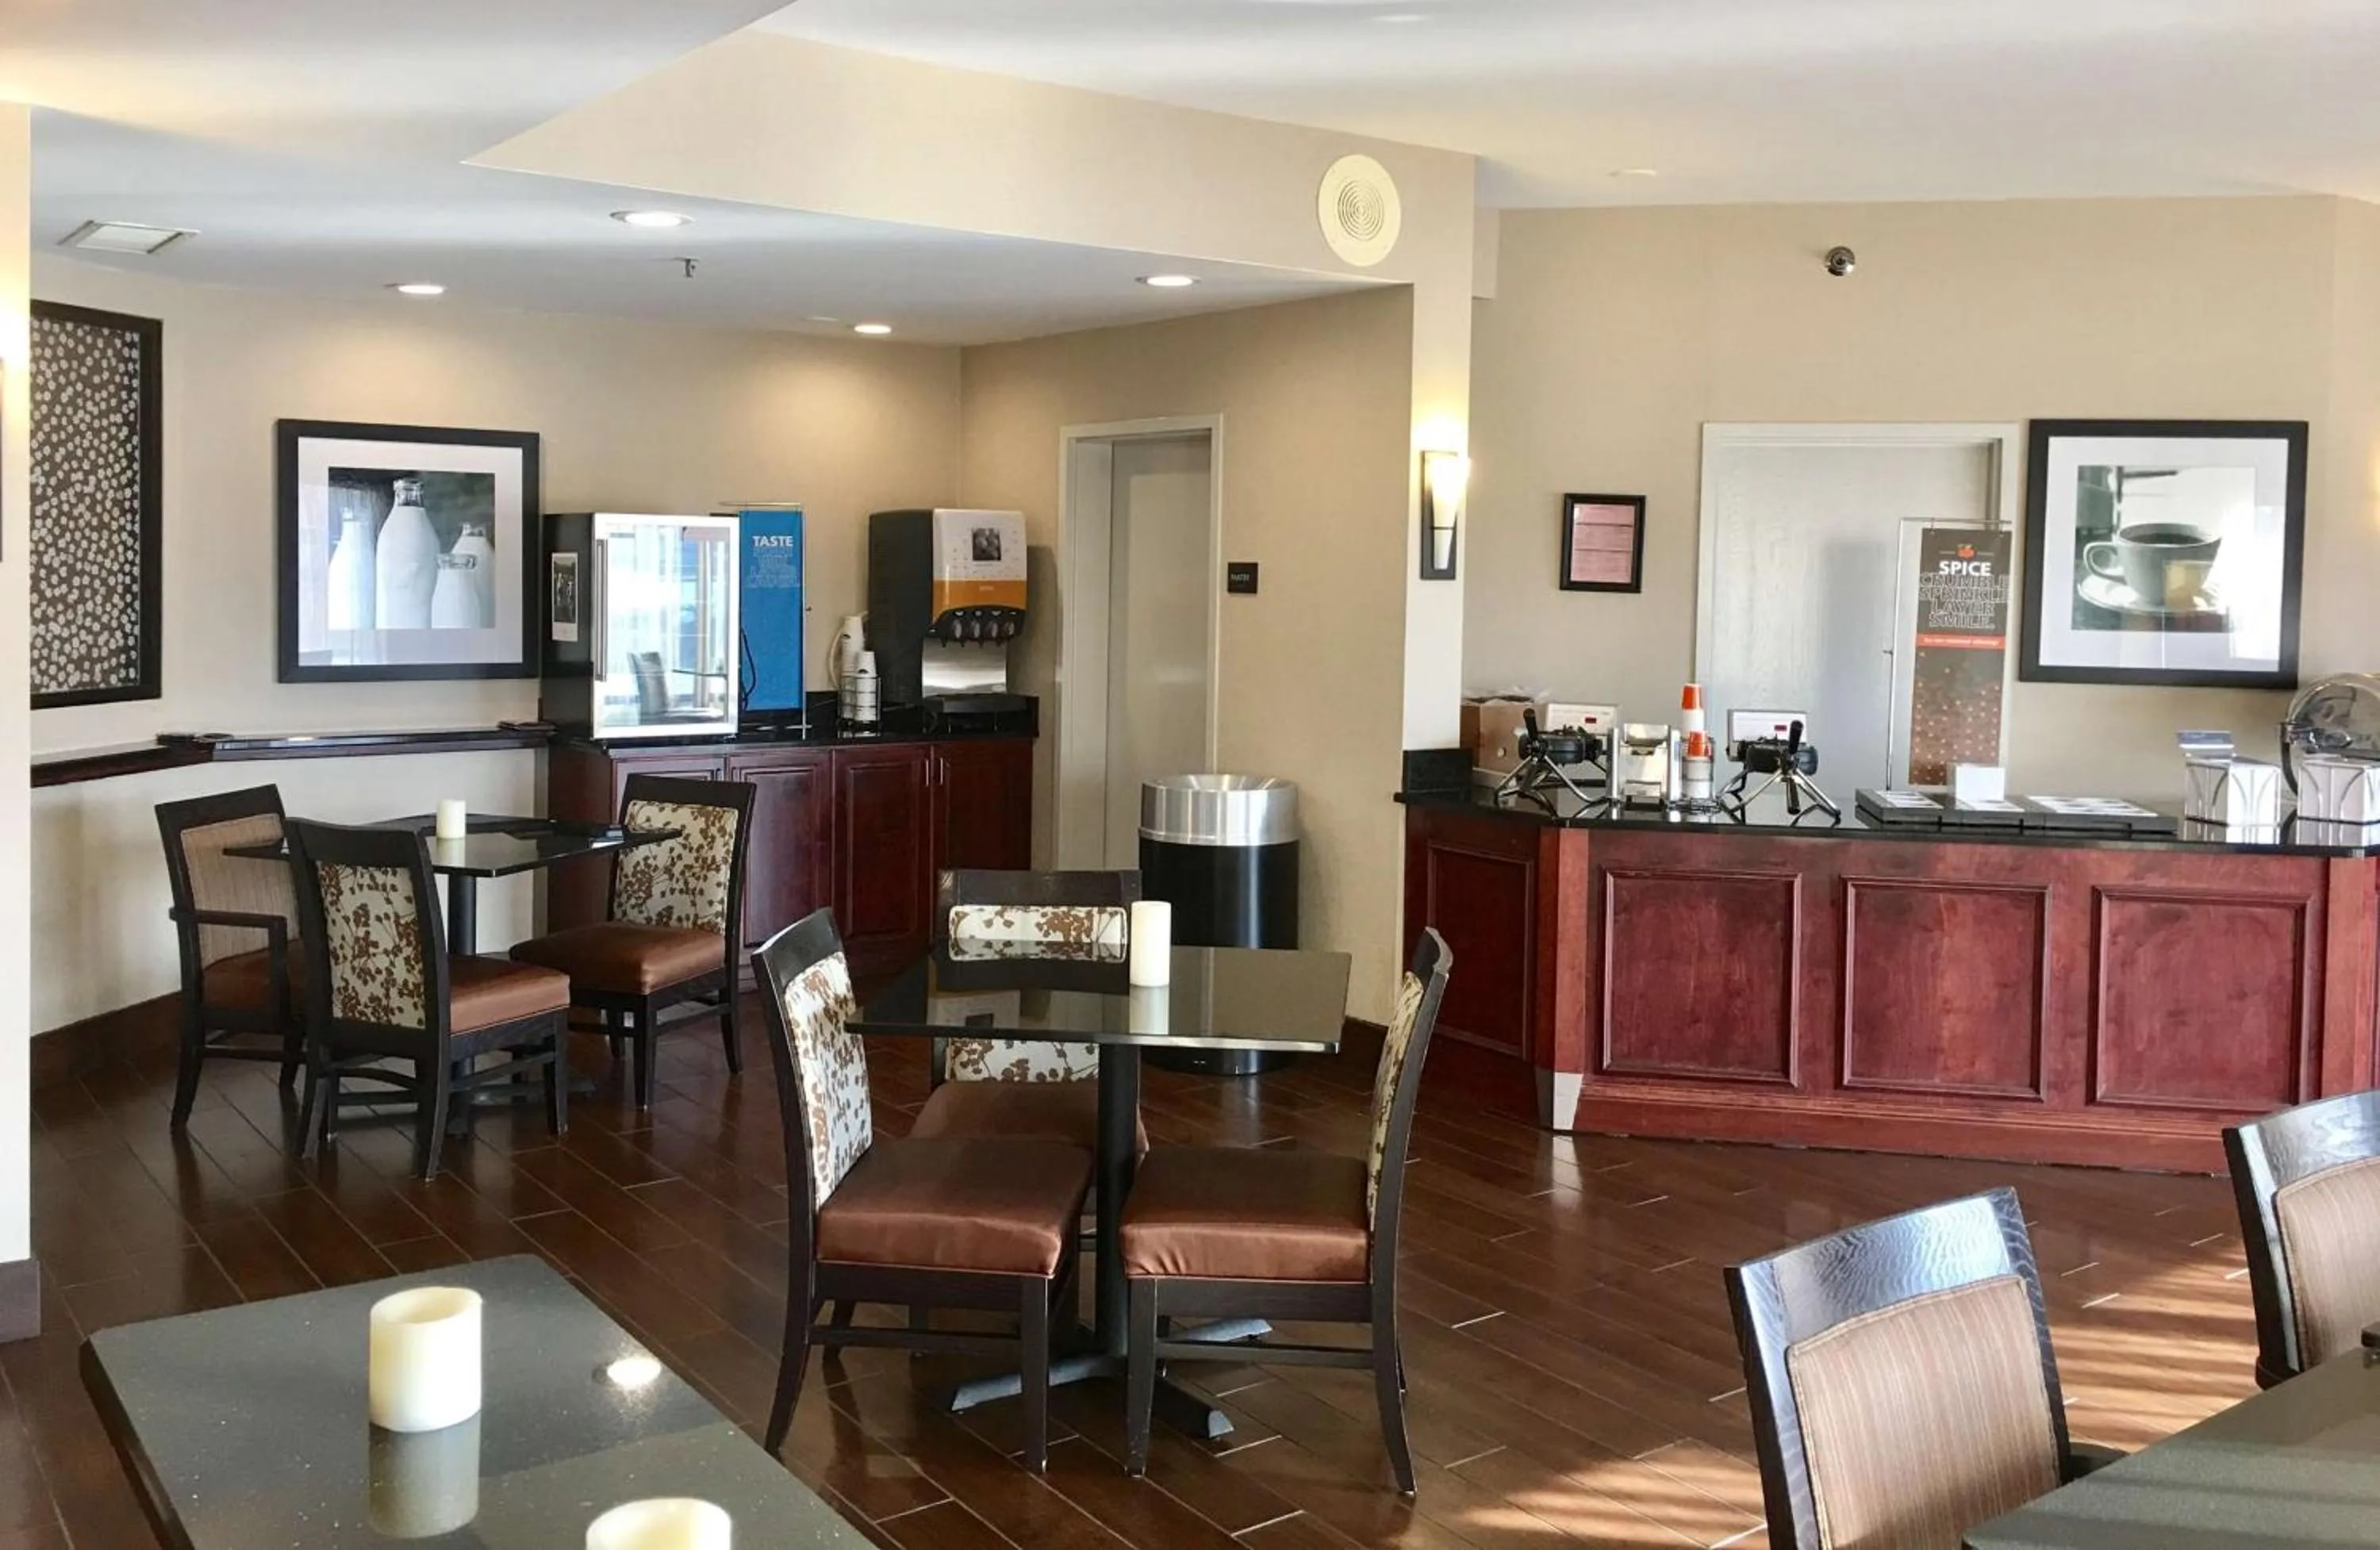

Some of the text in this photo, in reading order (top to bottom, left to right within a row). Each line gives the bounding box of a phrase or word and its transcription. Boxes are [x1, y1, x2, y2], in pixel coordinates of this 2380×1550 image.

[752, 535, 793, 547] TASTE
[1939, 560, 1992, 576] SPICE
[1930, 600, 1994, 616] LAYER
